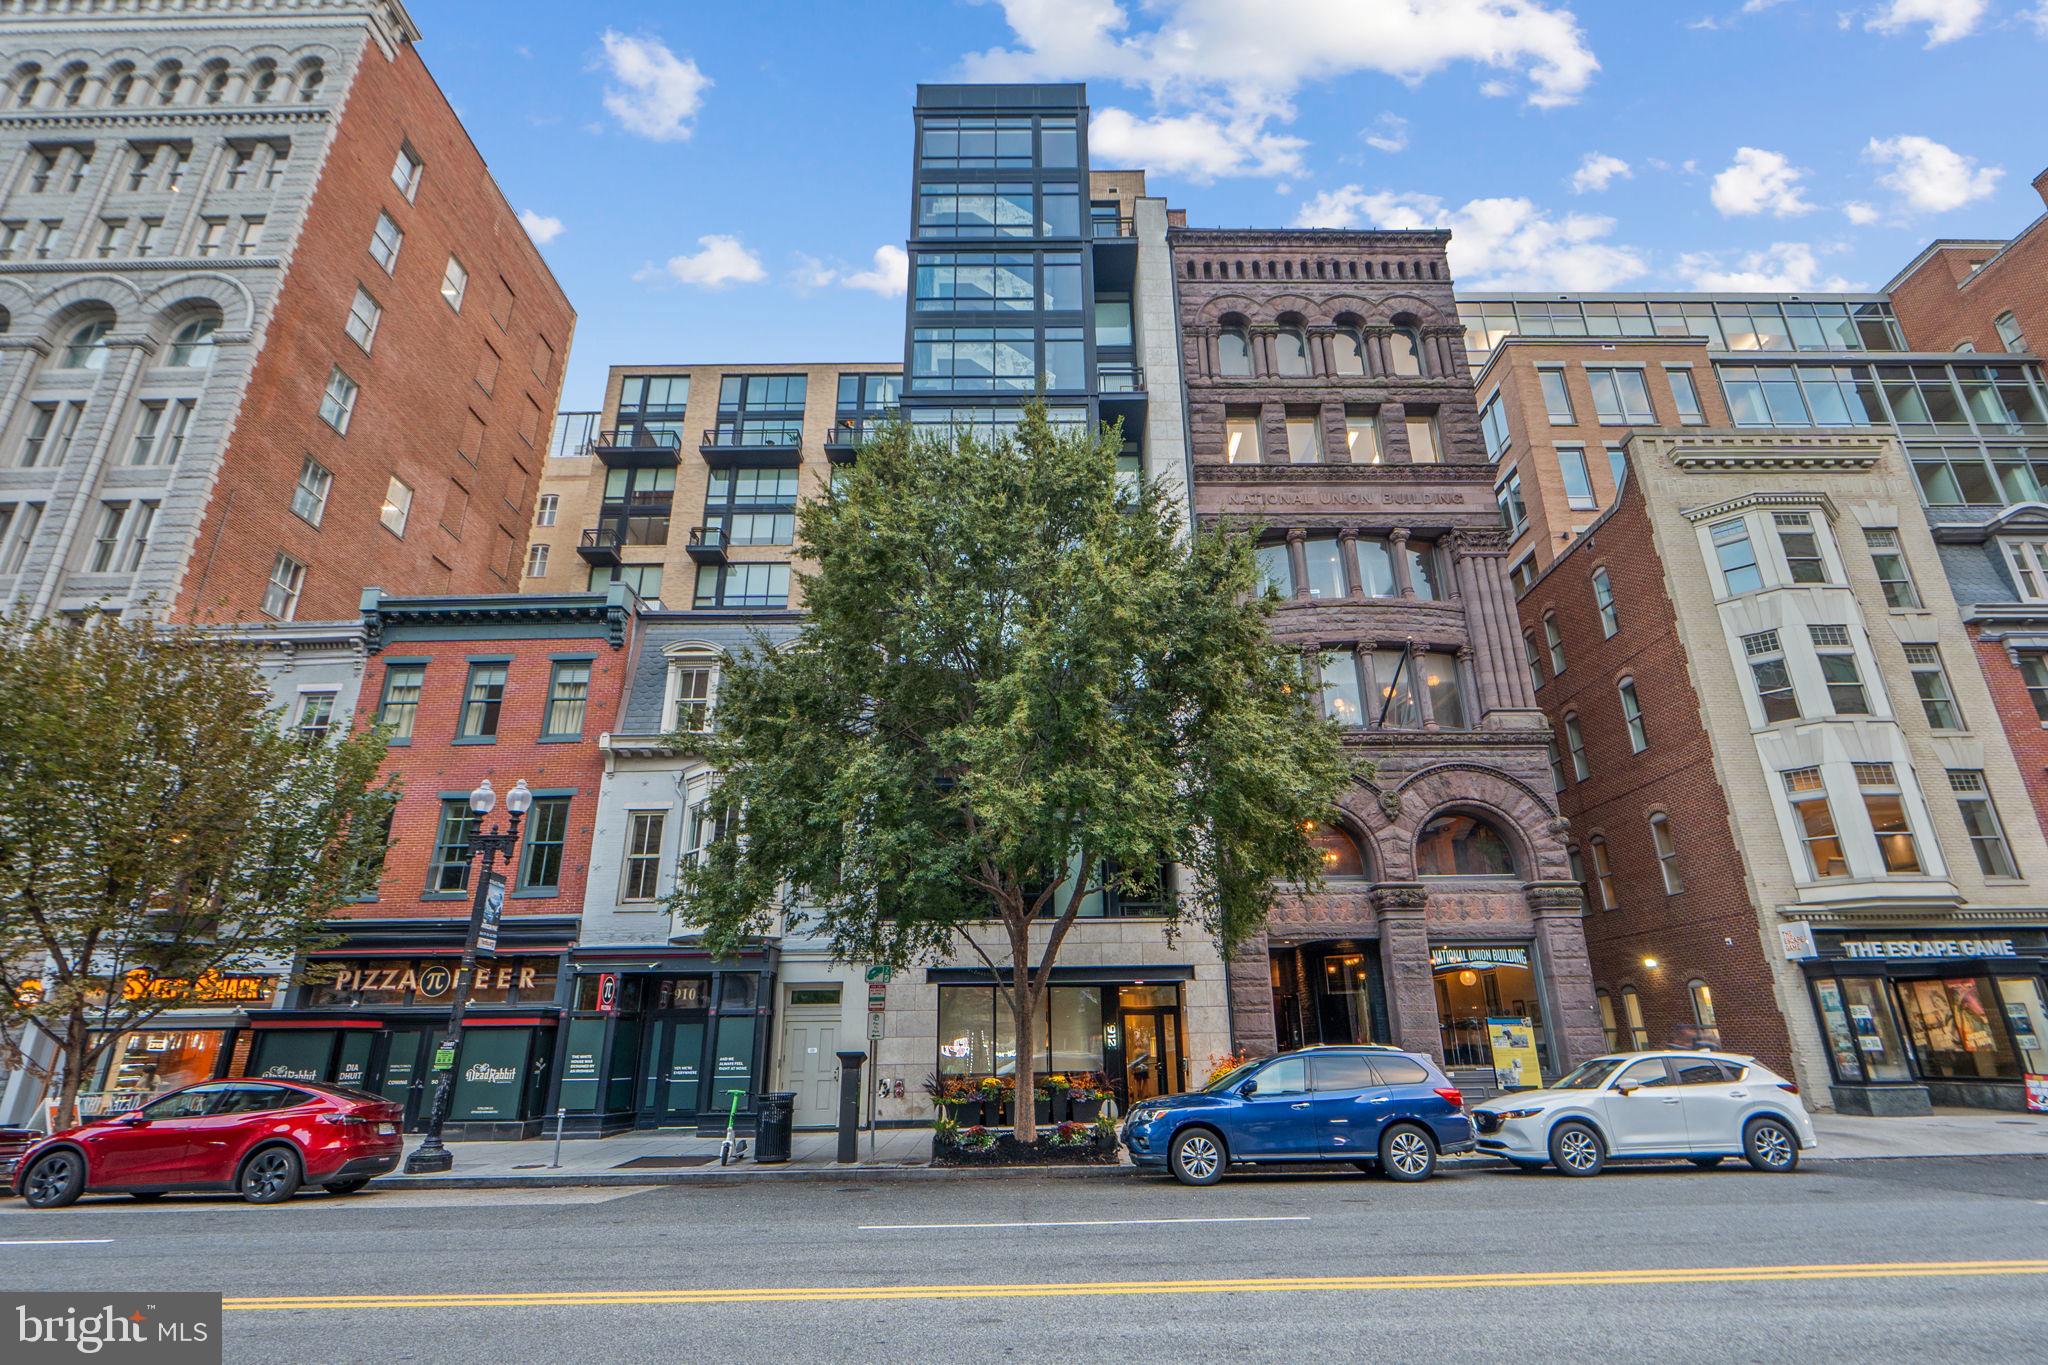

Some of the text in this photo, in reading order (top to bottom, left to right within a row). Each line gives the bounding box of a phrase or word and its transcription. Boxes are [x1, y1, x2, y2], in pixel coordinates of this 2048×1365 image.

[1229, 493, 1465, 506] NATIONAL UNION BUILDING
[1840, 939, 2016, 957] THE ESCAPE GAME
[1432, 949, 1528, 965] NATIONAL UNION BUILDING
[335, 968, 417, 991] PIZZA
[674, 988, 696, 1000] 910
[1107, 1024, 1117, 1047] 912
[466, 1067, 516, 1082] Dead Rabbit
